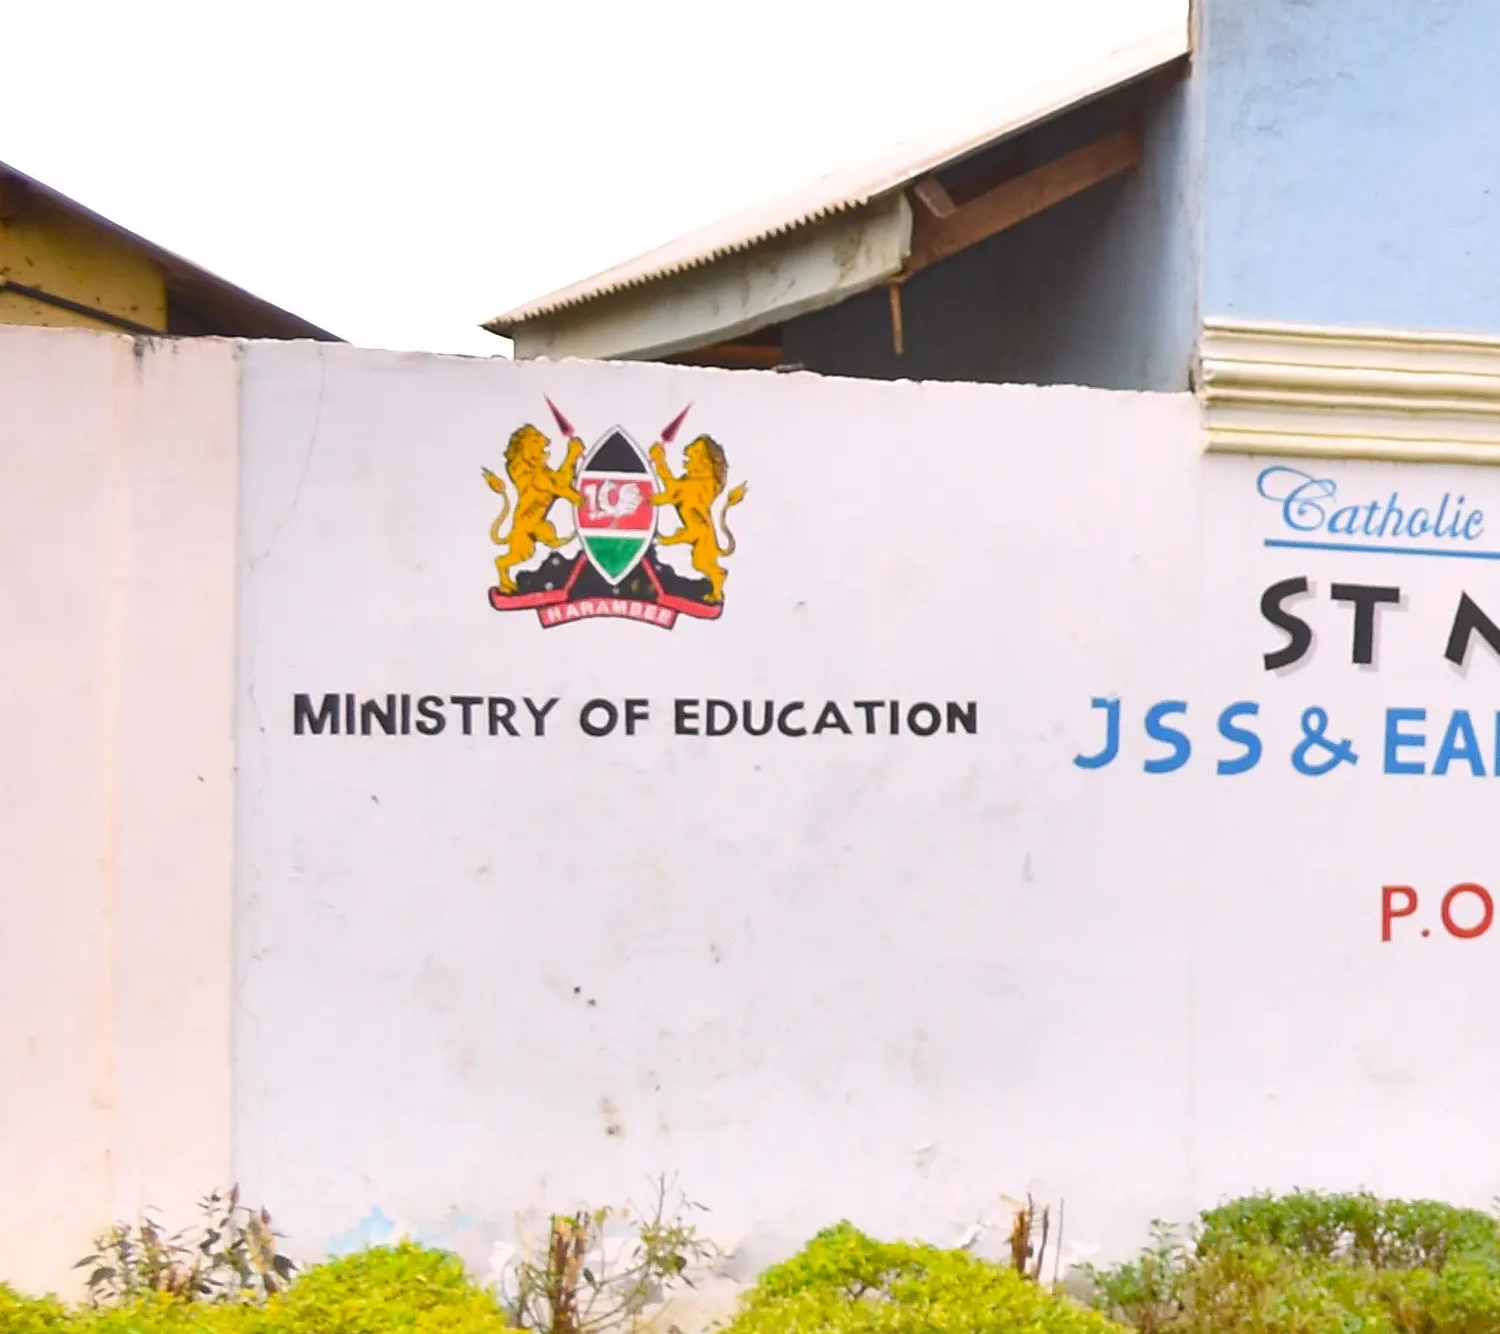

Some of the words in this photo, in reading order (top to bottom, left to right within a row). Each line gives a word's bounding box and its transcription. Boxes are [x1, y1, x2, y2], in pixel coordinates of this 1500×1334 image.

[1255, 465, 1485, 541] Catholic
[1261, 577, 1399, 670] ST
[294, 693, 559, 736] MINISTRY
[579, 699, 649, 737] OF
[674, 699, 977, 737] EDUCATION
[1073, 698, 1262, 775] JSS
[1291, 706, 1358, 776] &
